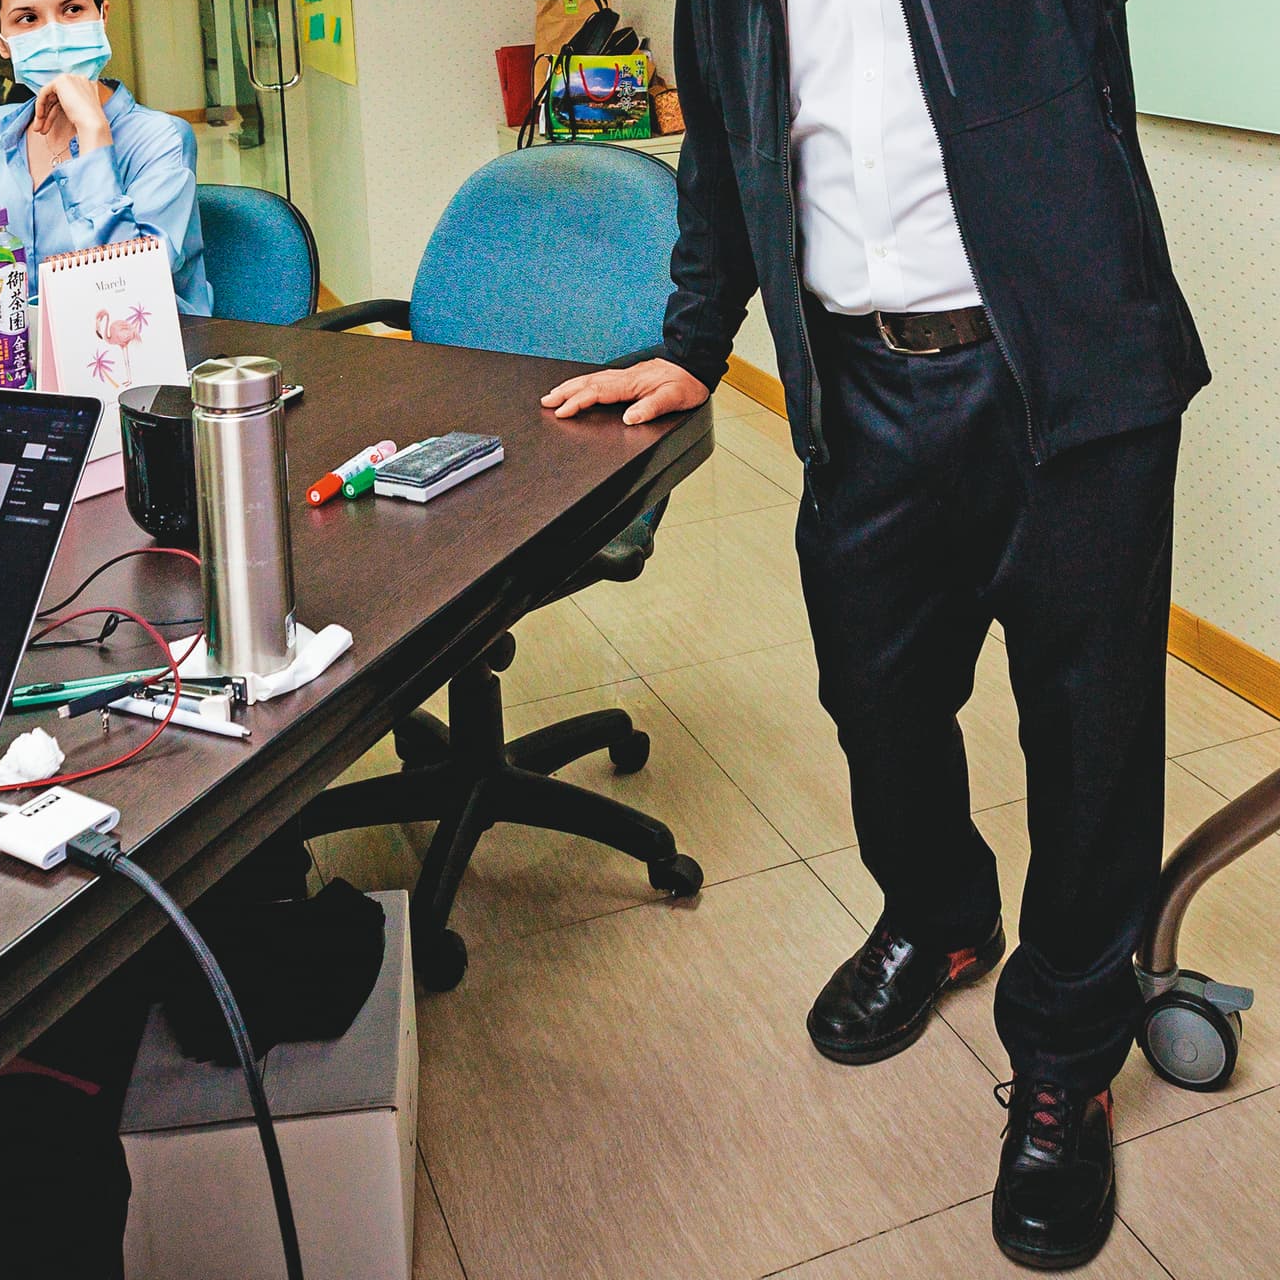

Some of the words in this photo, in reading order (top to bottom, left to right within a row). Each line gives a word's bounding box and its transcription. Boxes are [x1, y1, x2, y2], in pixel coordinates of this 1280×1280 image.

[608, 128, 651, 139] TAIWAN
[95, 276, 126, 290] March
[6, 270, 26, 332] 御茶園
[12, 335, 27, 371] 金萱
